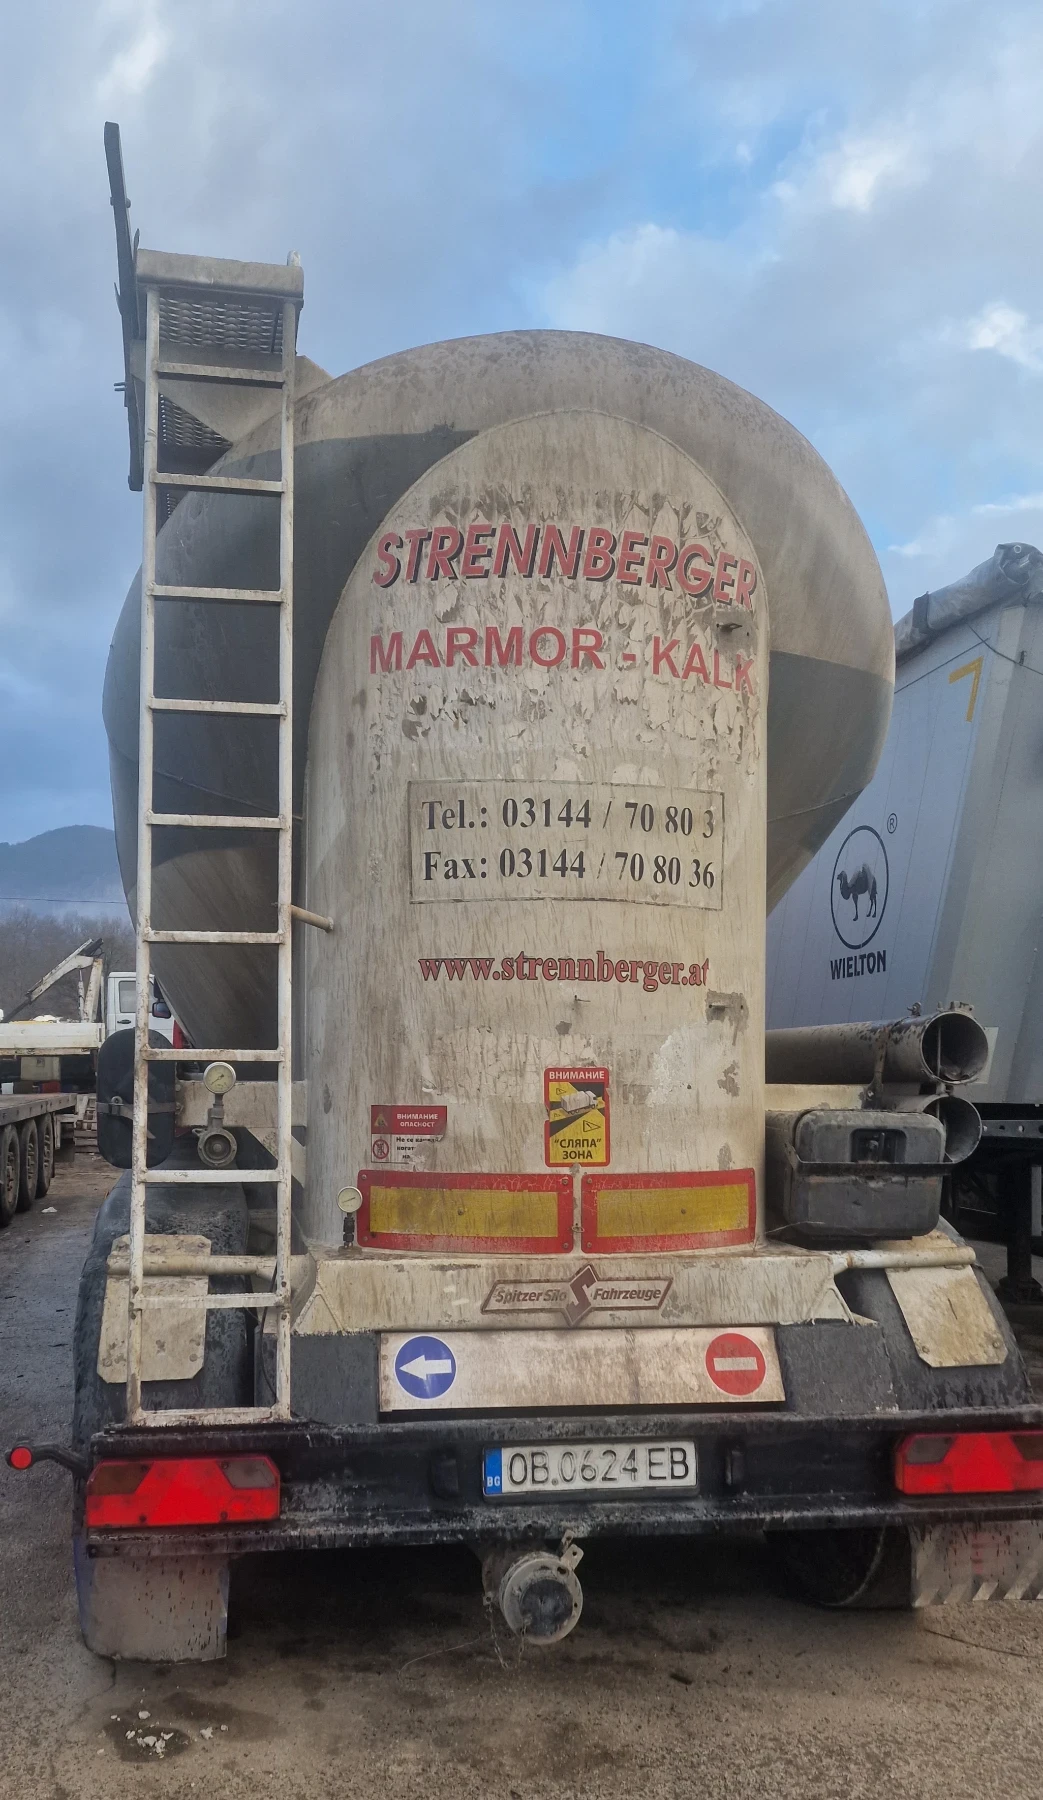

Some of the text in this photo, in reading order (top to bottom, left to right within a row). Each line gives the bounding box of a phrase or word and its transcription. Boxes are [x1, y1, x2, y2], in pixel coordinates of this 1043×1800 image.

[372, 523, 758, 610] STRENNBERGER
[369, 625, 606, 674] MARMOR
[652, 635, 756, 696] KALK
[421, 799, 488, 831] Tel.:
[502, 797, 591, 829] 03144
[625, 801, 655, 833] 70
[664, 805, 693, 836] 80
[423, 850, 488, 881] Fax:
[499, 847, 586, 879] 03144
[614, 851, 644, 882] 70
[653, 854, 681, 886] 80
[688, 858, 715, 889] 36
[418, 950, 710, 993] www.strennberger.at
[830, 949, 887, 981] WIELTON
[549, 1070, 605, 1080] ВНИМАНИЕ
[562, 1150, 593, 1160] ЗОНА
[495, 1289, 542, 1304] Spitzer
[543, 1289, 567, 1302] Silo
[593, 1287, 662, 1303] Fahrzeuge
[486, 1475, 501, 1487] BG
